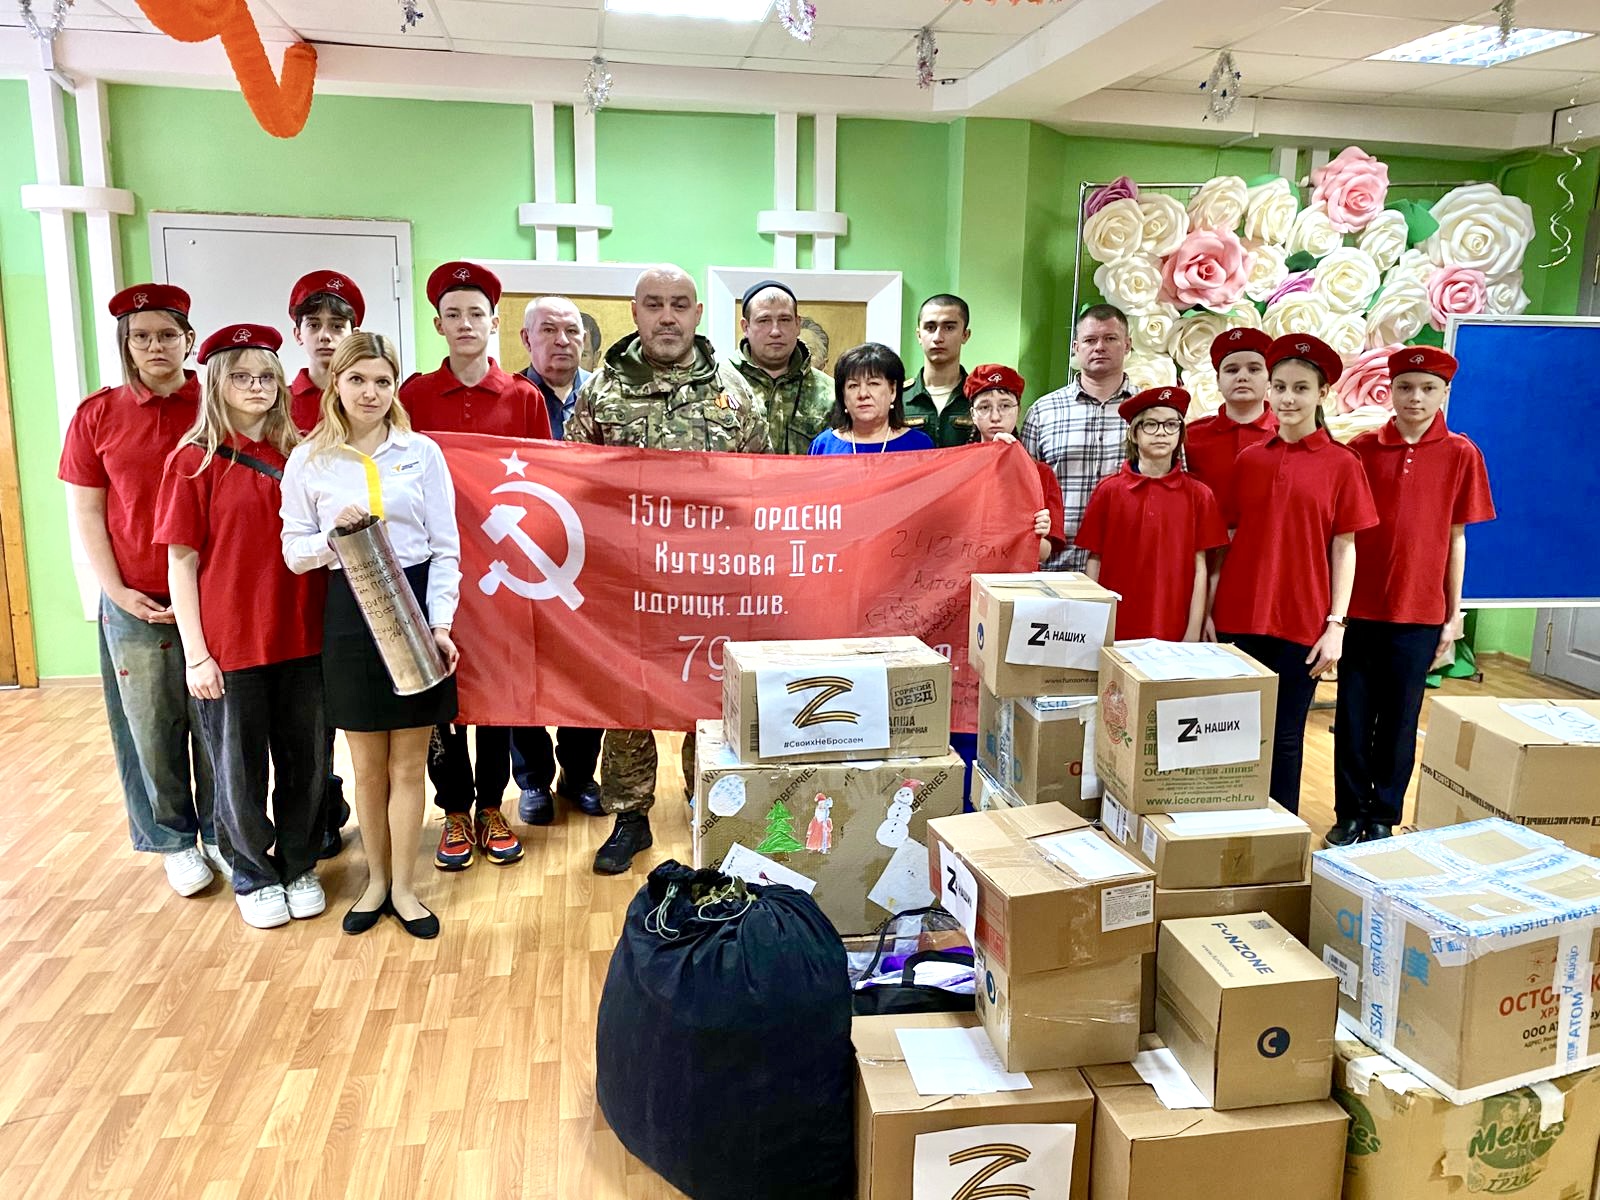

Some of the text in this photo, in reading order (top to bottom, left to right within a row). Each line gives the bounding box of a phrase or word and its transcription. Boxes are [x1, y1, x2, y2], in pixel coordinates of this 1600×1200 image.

[629, 494, 842, 531] 150 СТР. ОРДЕНА
[633, 590, 789, 618] ИДРИЦК. ДИВ.
[1052, 630, 1086, 644] НАШИХ
[895, 690, 934, 708] ОБЕД
[1205, 720, 1240, 735] НАШИХ
[784, 736, 864, 750] #СвоихНеБросаем
